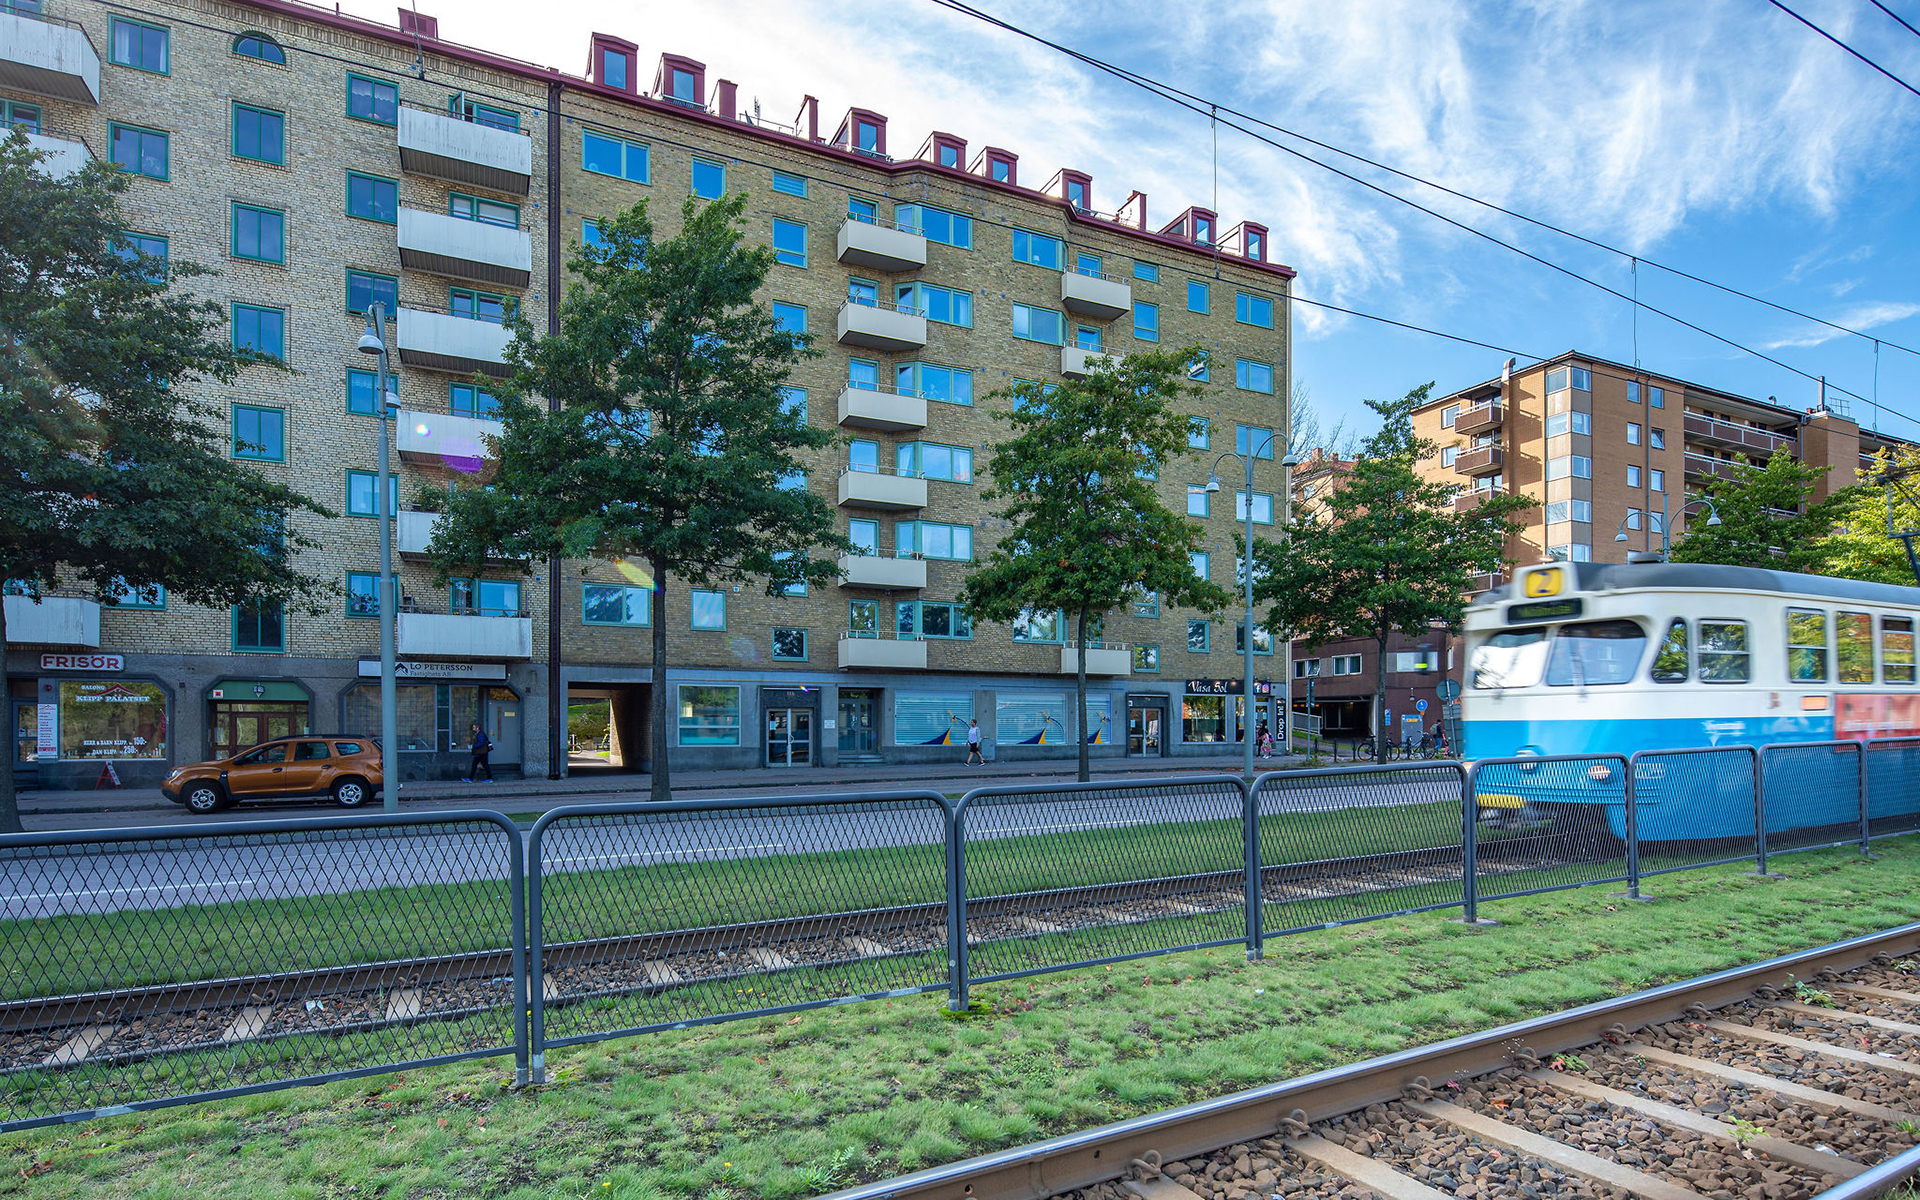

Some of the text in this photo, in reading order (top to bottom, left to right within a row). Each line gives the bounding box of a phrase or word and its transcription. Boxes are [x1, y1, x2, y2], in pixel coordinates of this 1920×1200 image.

[1534, 571, 1554, 594] 2
[43, 655, 120, 669] FRISÖR
[1188, 681, 1228, 693] Vasa Sol
[1277, 705, 1285, 740] Drop In!
